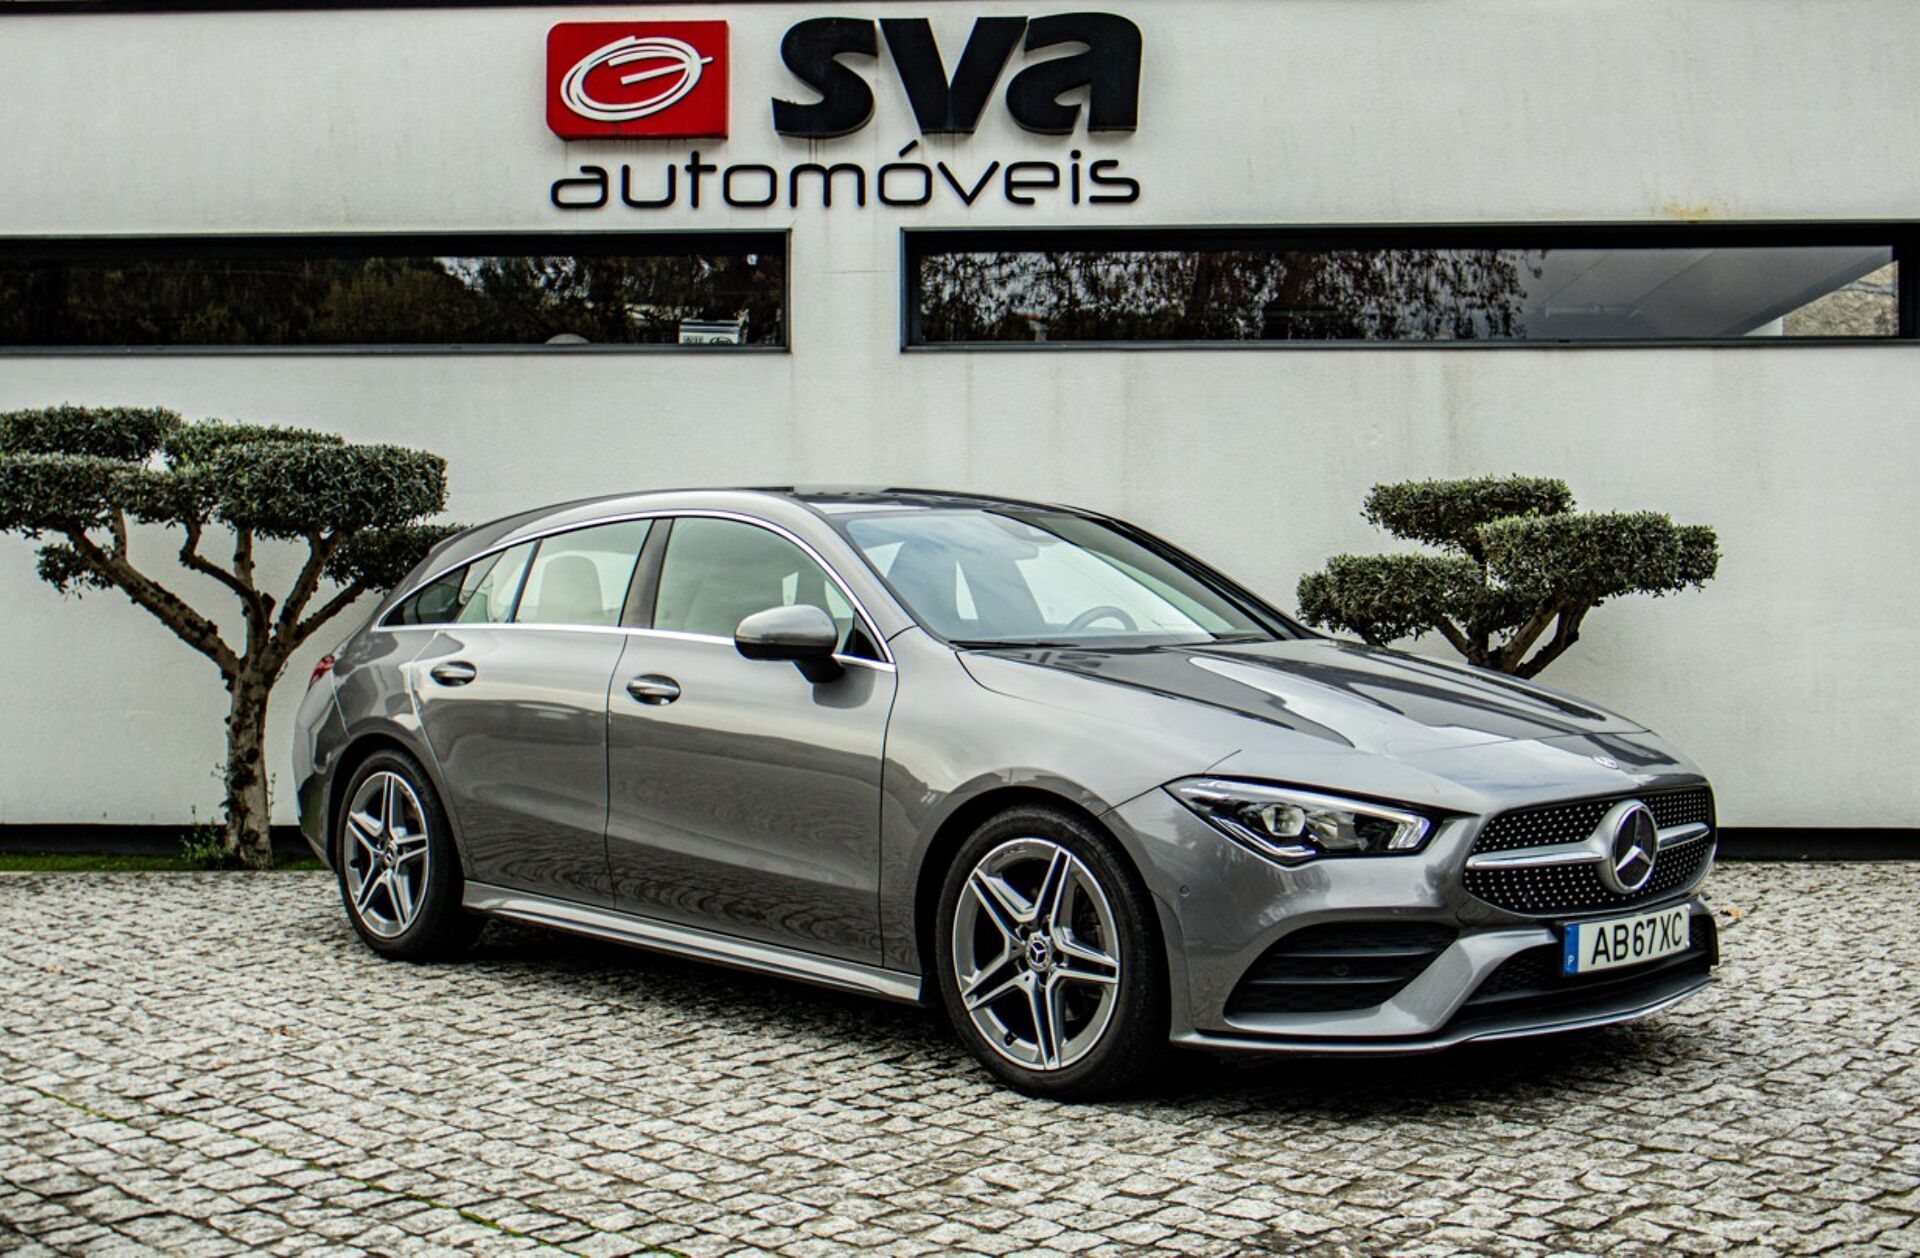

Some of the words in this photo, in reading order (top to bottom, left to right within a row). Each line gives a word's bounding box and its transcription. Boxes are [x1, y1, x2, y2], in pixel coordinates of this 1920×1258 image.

[771, 12, 1143, 137] sva
[550, 140, 1141, 209] automóveis
[1591, 911, 1683, 965] AB67XC
